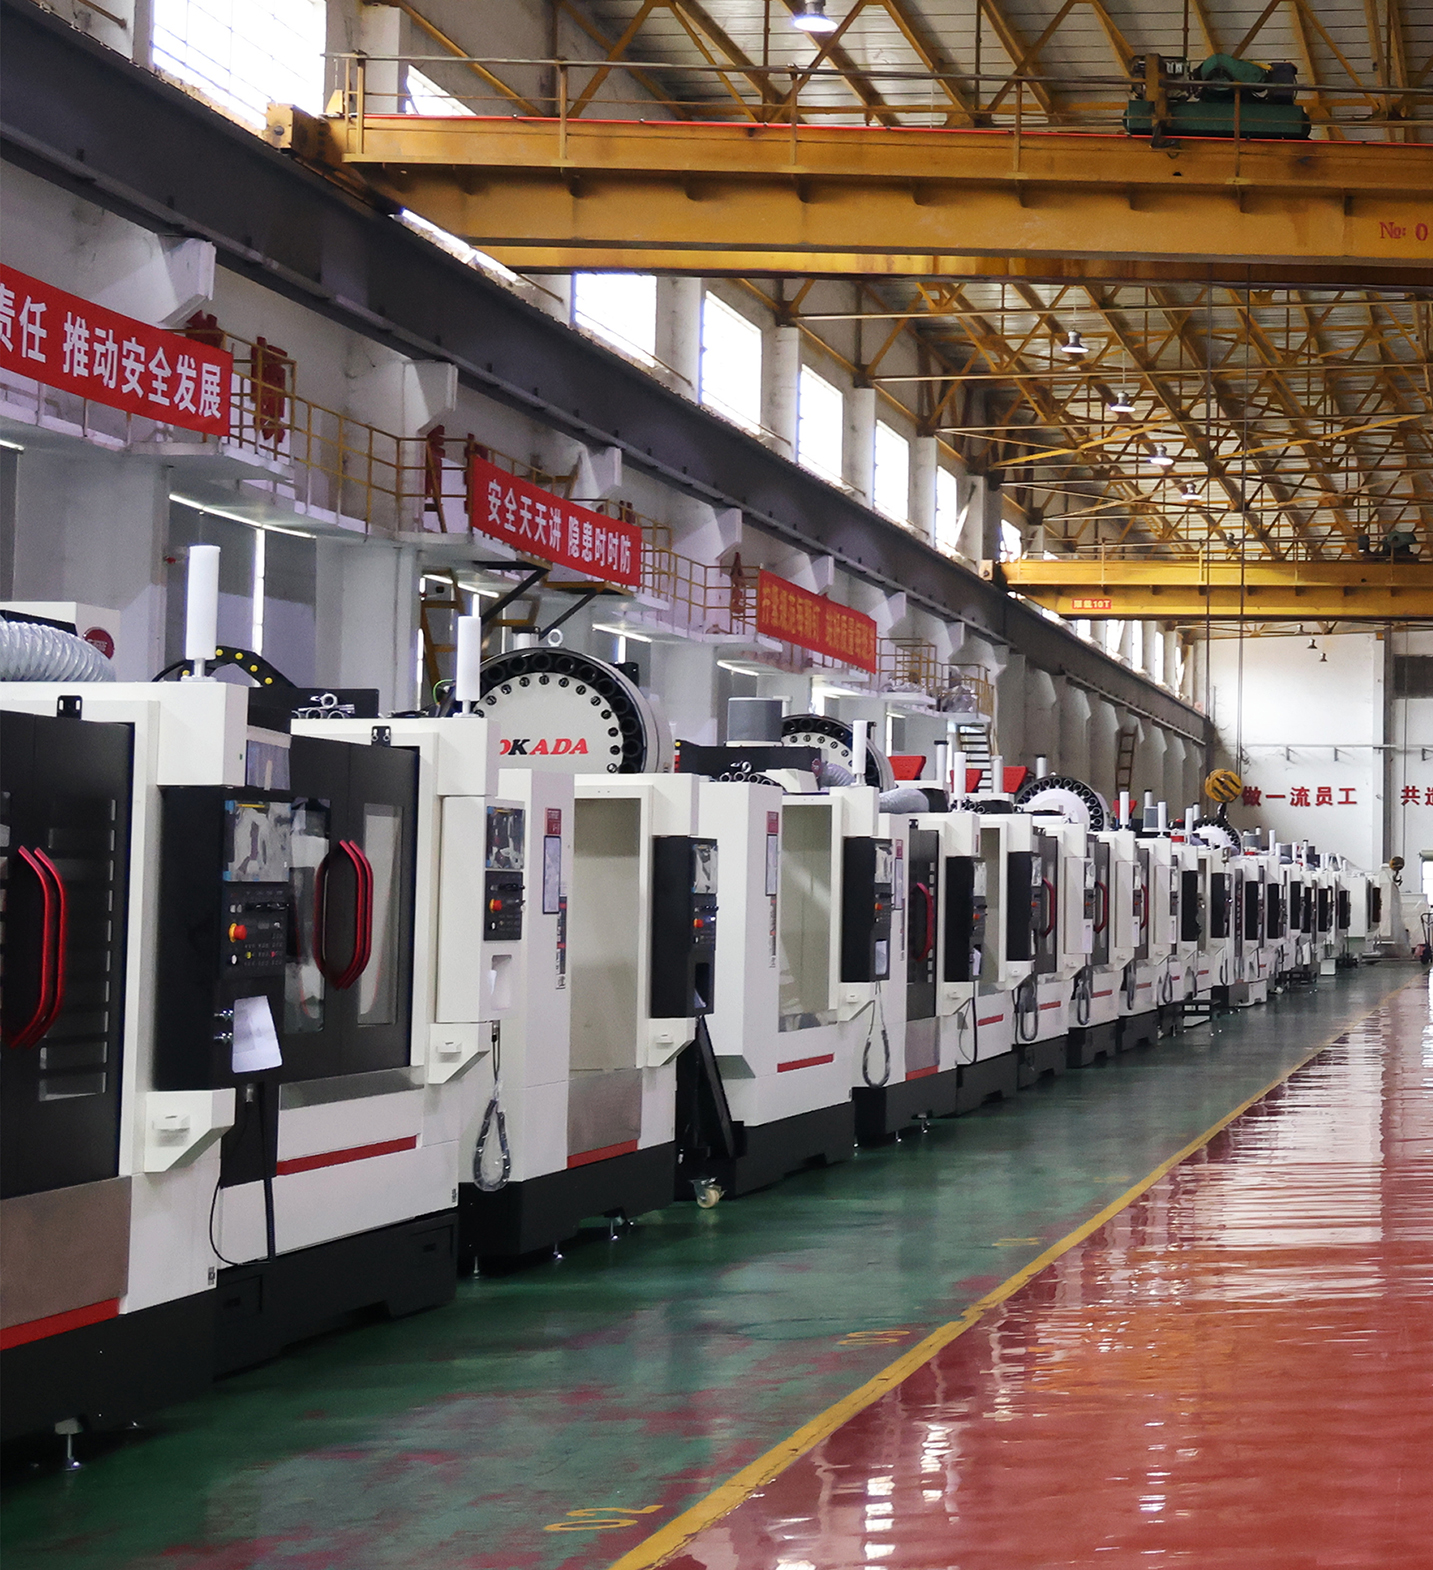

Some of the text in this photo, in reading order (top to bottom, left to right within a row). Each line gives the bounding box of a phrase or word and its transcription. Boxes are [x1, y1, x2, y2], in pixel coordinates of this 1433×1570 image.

[63, 311, 222, 419] 推动安全发展
[488, 478, 631, 575] 安全天天讲 隐患时时防
[1242, 785, 1358, 806] 做一流员工
